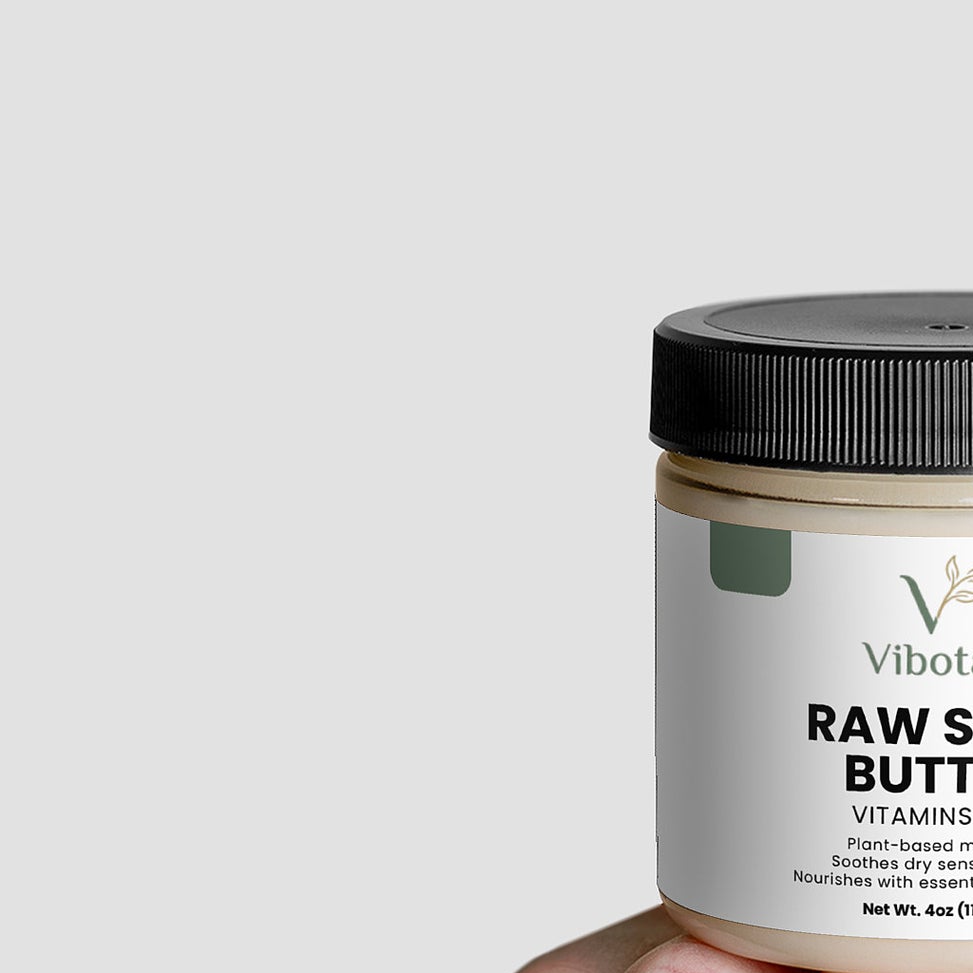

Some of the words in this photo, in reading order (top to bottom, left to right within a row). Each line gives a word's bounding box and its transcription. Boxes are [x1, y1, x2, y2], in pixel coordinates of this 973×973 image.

[807, 702, 931, 746] RAW
[852, 804, 972, 826] VITAMINS
[847, 836, 953, 853] Plant-based
[831, 854, 899, 871] Soothes
[904, 856, 933, 875] dry
[793, 869, 873, 888] Nourishes
[877, 874, 913, 889] with
[862, 902, 891, 916] Net
[893, 903, 922, 917] Wt.
[924, 903, 955, 917] 4oz
